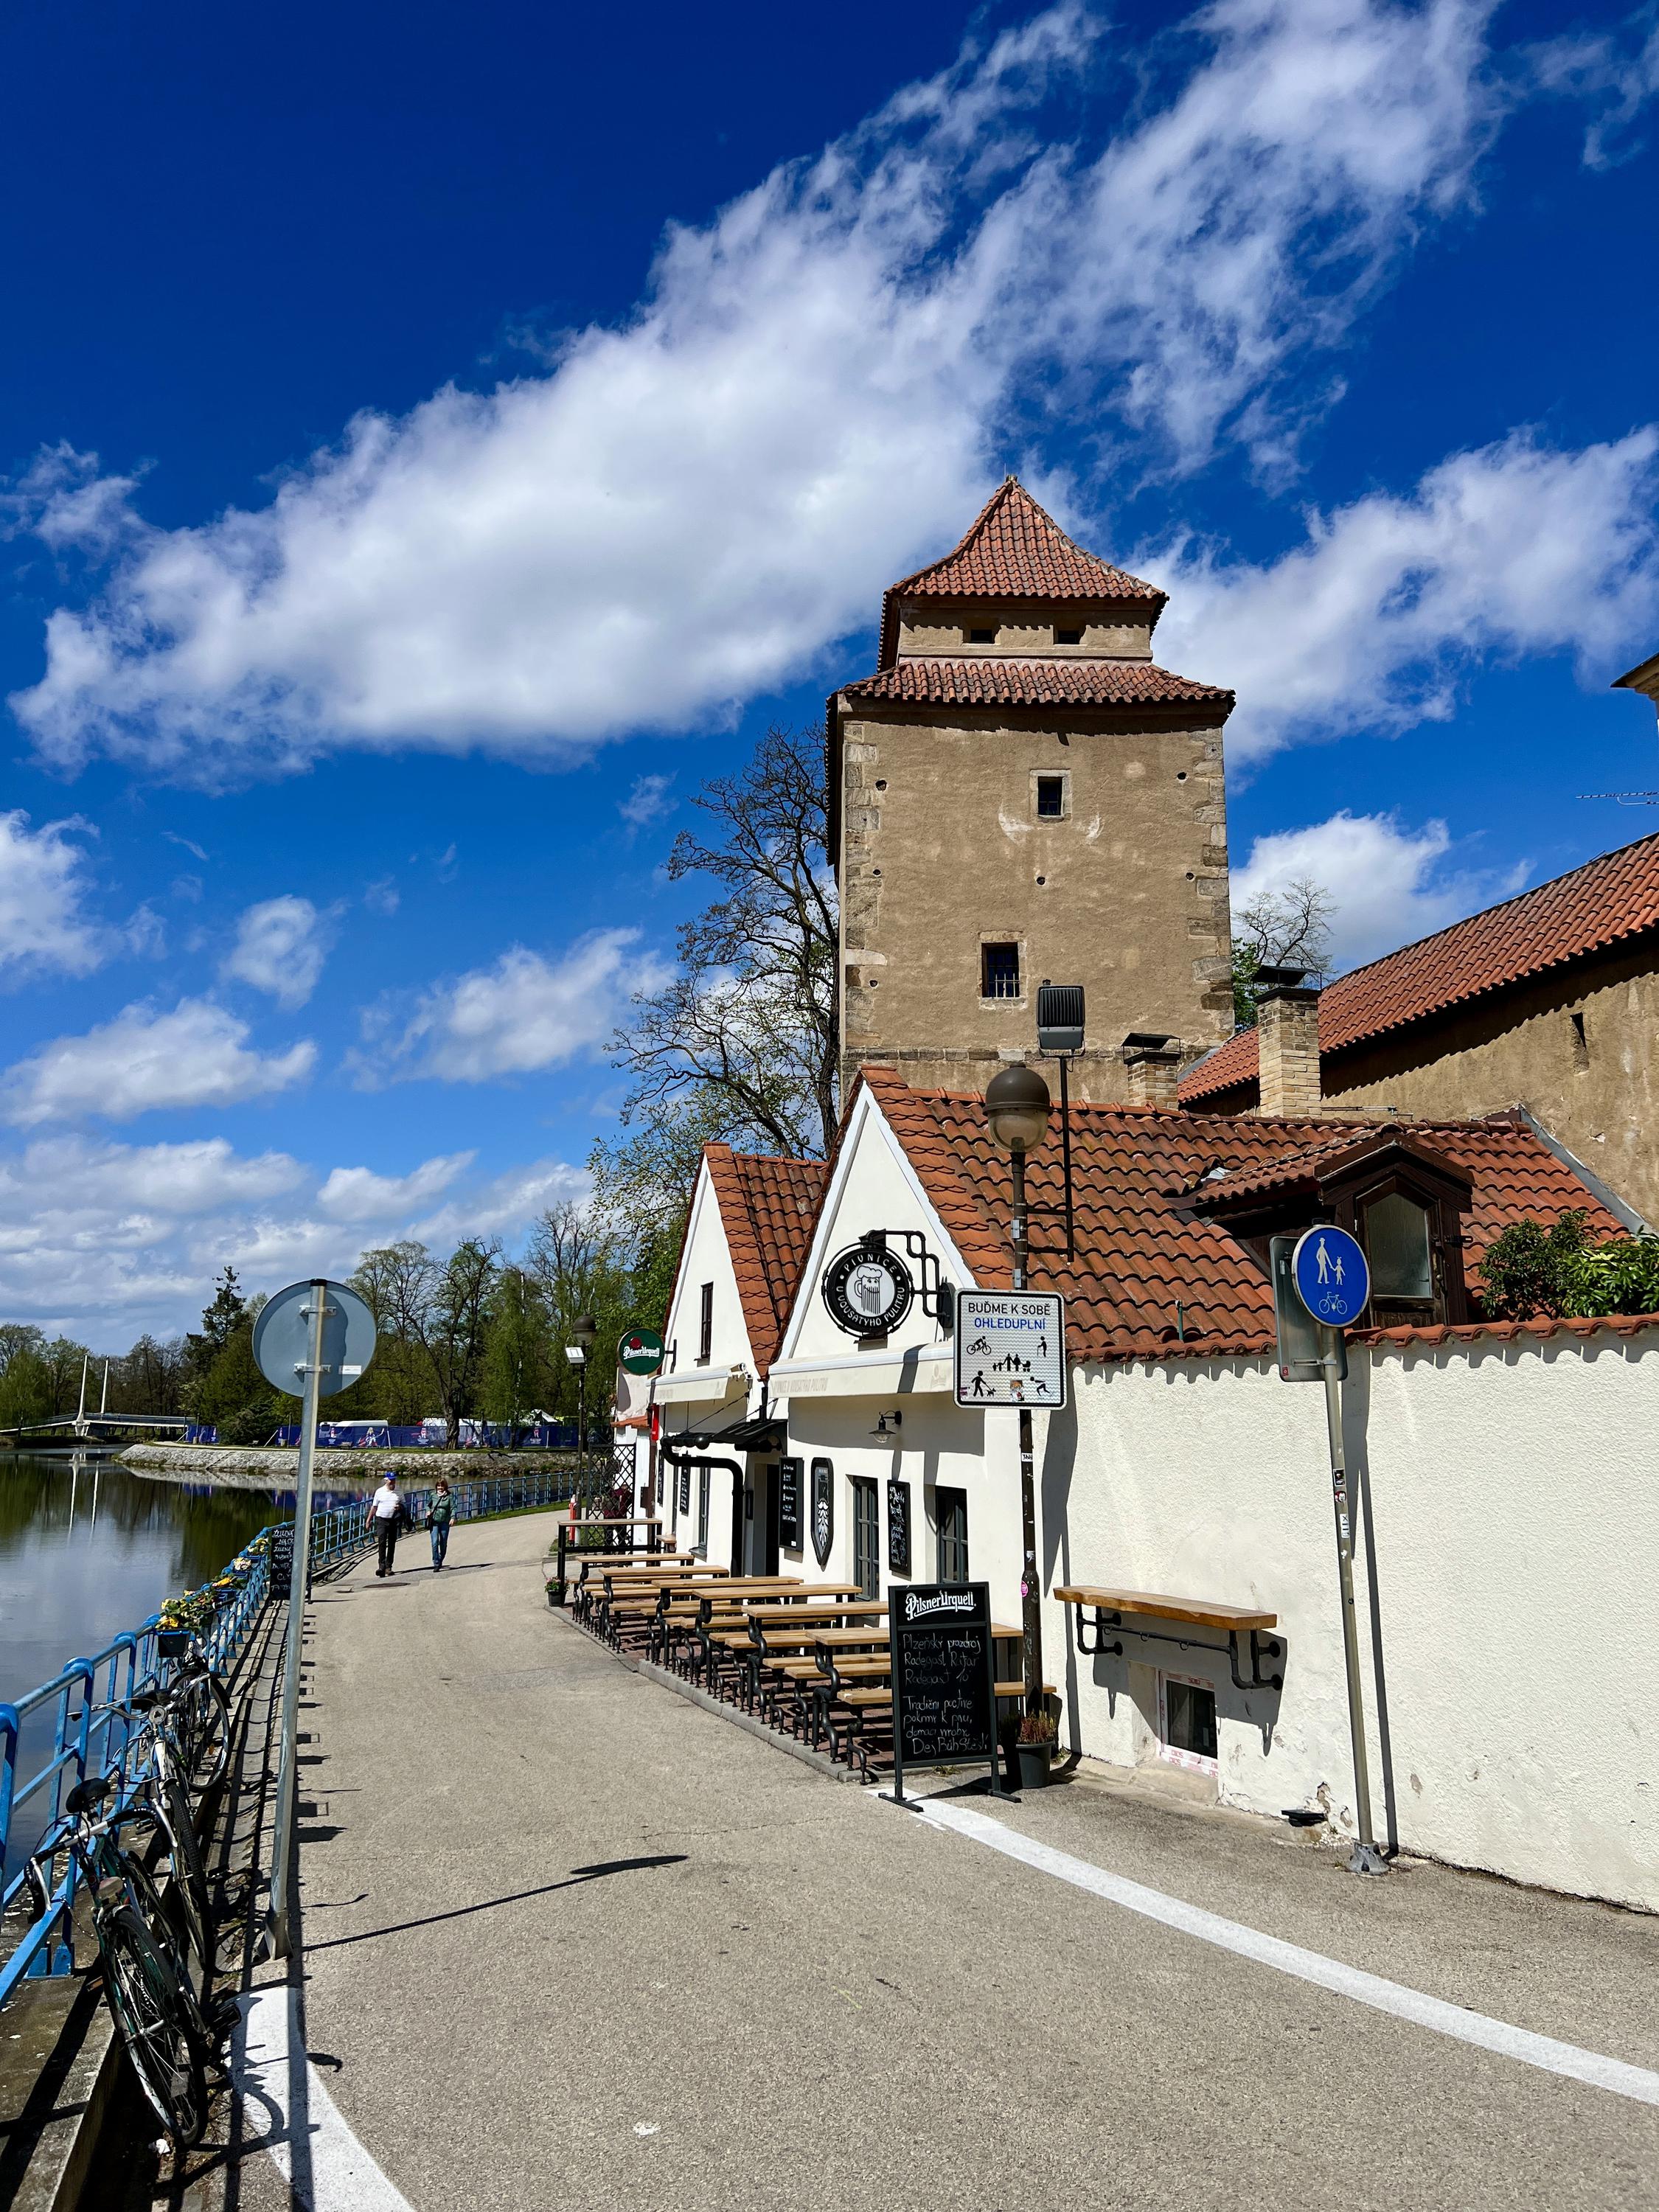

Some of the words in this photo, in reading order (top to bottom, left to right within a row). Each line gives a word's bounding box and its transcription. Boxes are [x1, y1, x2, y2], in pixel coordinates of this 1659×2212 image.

[844, 1253, 897, 1273] PIVNICE
[884, 1287, 905, 1322] PULITRU
[968, 1301, 1007, 1314] BUĎME
[1011, 1304, 1019, 1315] K
[1022, 1304, 1051, 1315] SOBĚ
[974, 1318, 1046, 1330] OHLEDUPLNÍ
[905, 1593, 942, 1621] Pilsner
[905, 1651, 947, 1670] Radegast
[905, 1669, 950, 1687] Radegast
[912, 1738, 936, 1756] Dej
